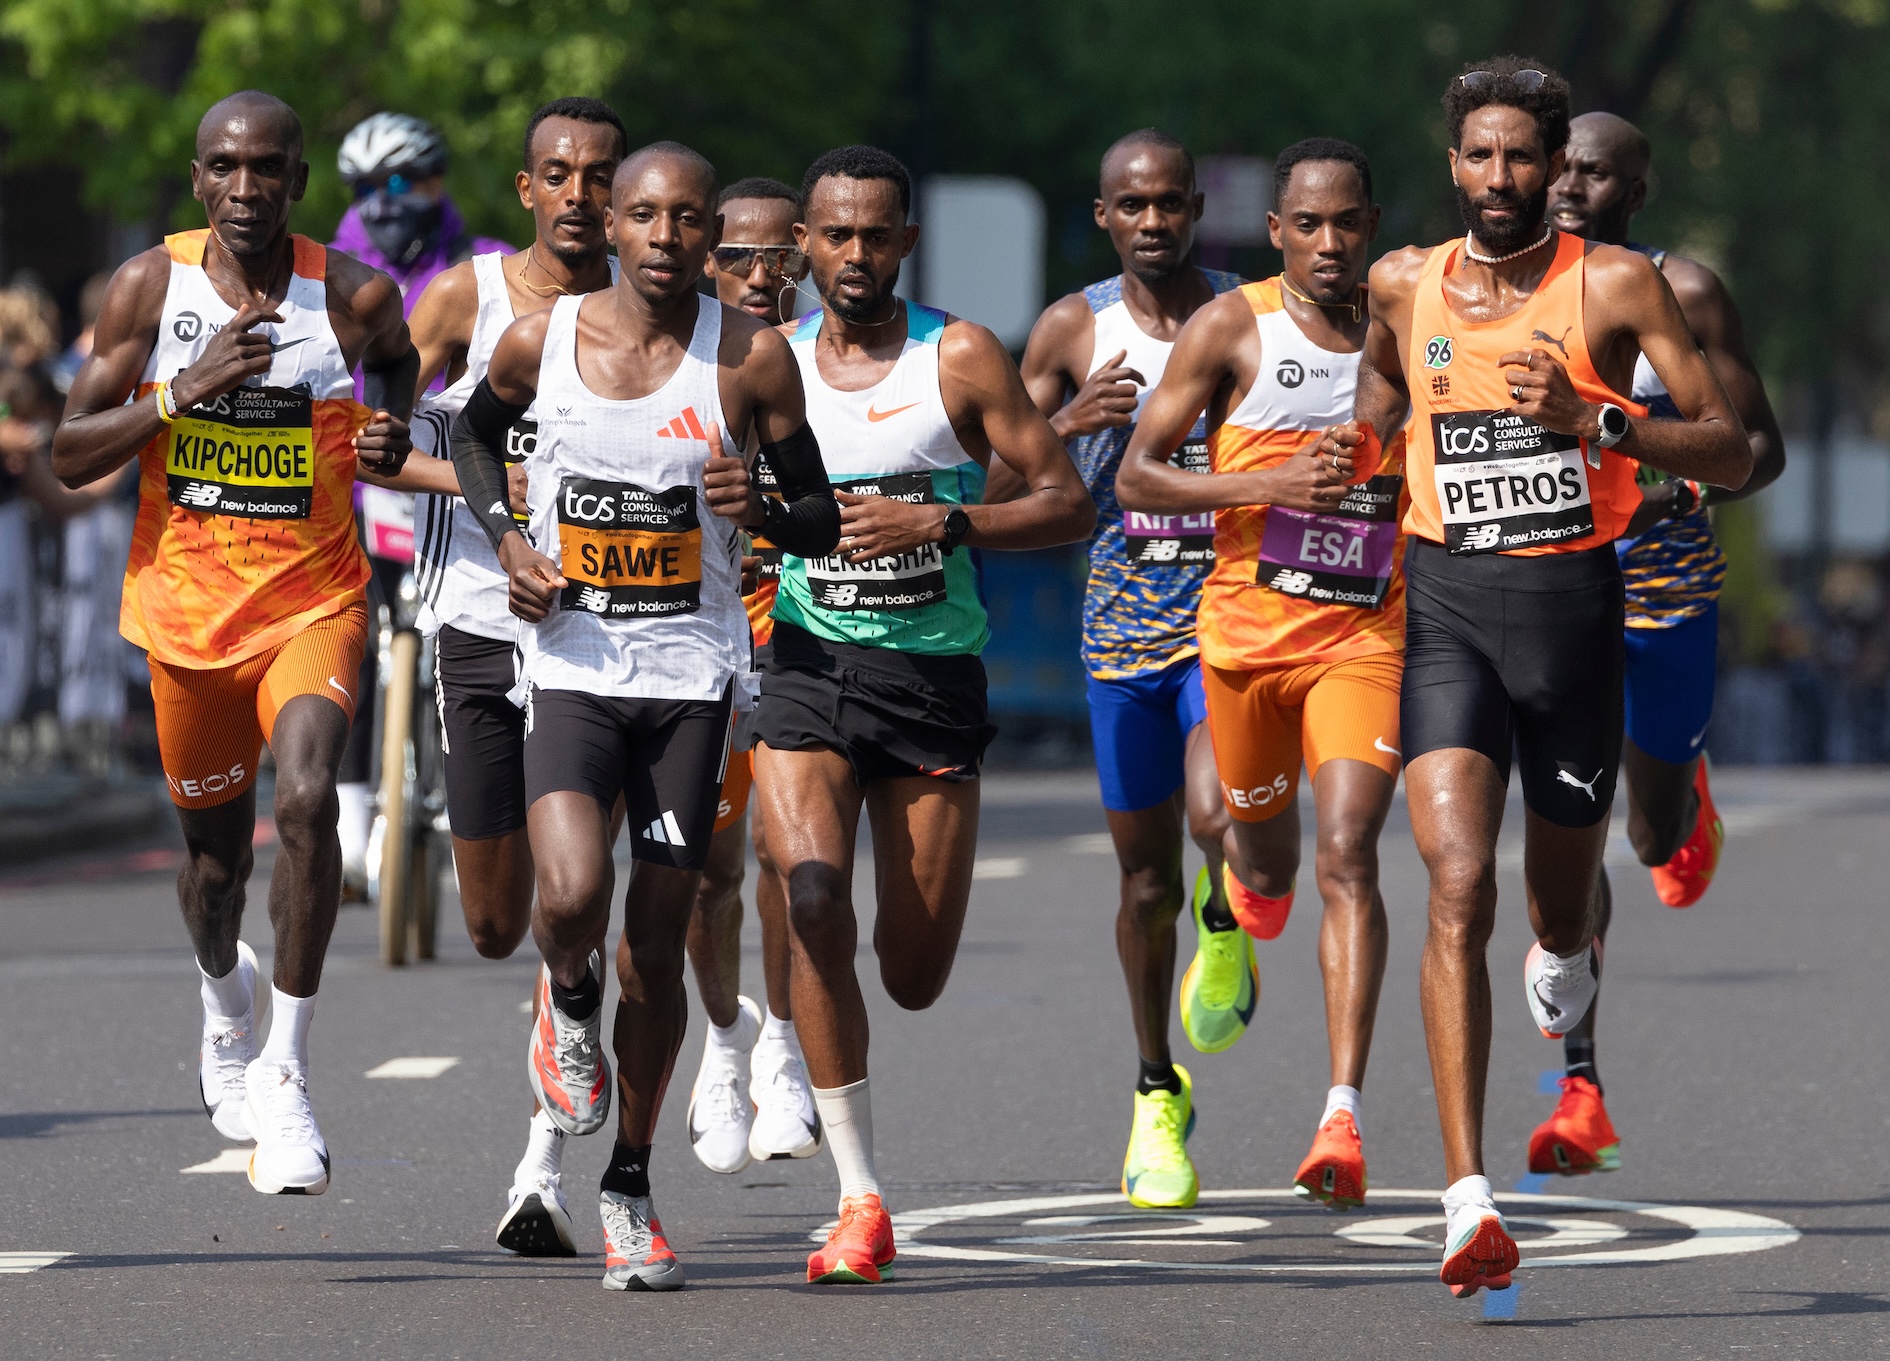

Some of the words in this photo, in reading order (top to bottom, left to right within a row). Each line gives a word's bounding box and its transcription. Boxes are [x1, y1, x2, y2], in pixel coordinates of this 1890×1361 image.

[1426, 338, 1452, 367] 96
[1310, 368, 1329, 378] NN
[237, 390, 266, 398] TATA
[193, 392, 231, 416] cs
[234, 399, 303, 409] CONSULTANCY
[235, 410, 276, 419] SERVICES
[1493, 415, 1524, 428] TATA
[1439, 423, 1489, 455] tcs
[1494, 425, 1550, 440] CONSULTA
[506, 426, 538, 458] tc
[1494, 437, 1542, 452] SERVICES
[174, 433, 308, 479] KIPCHOGE
[621, 491, 654, 501] TATA
[852, 485, 882, 495] TATA
[1343, 491, 1394, 504] NSULTANCY
[1444, 467, 1582, 515] PETROS
[220, 499, 246, 512] new
[247, 501, 298, 514] balance
[565, 486, 615, 522] tcs
[621, 502, 688, 517] CONSULTANCY
[1339, 501, 1377, 514] ERVICES
[621, 513, 669, 524] SERVICES
[1503, 532, 1531, 546] new
[1531, 524, 1581, 542] balance
[1180, 550, 1205, 561] new
[1299, 529, 1364, 569] ESA
[581, 543, 680, 579] SAWE
[859, 595, 884, 606] new
[885, 589, 934, 605] balance
[1309, 586, 1335, 599] new
[1335, 588, 1378, 604] balance
[611, 602, 637, 613] new
[638, 600, 688, 613] balance
